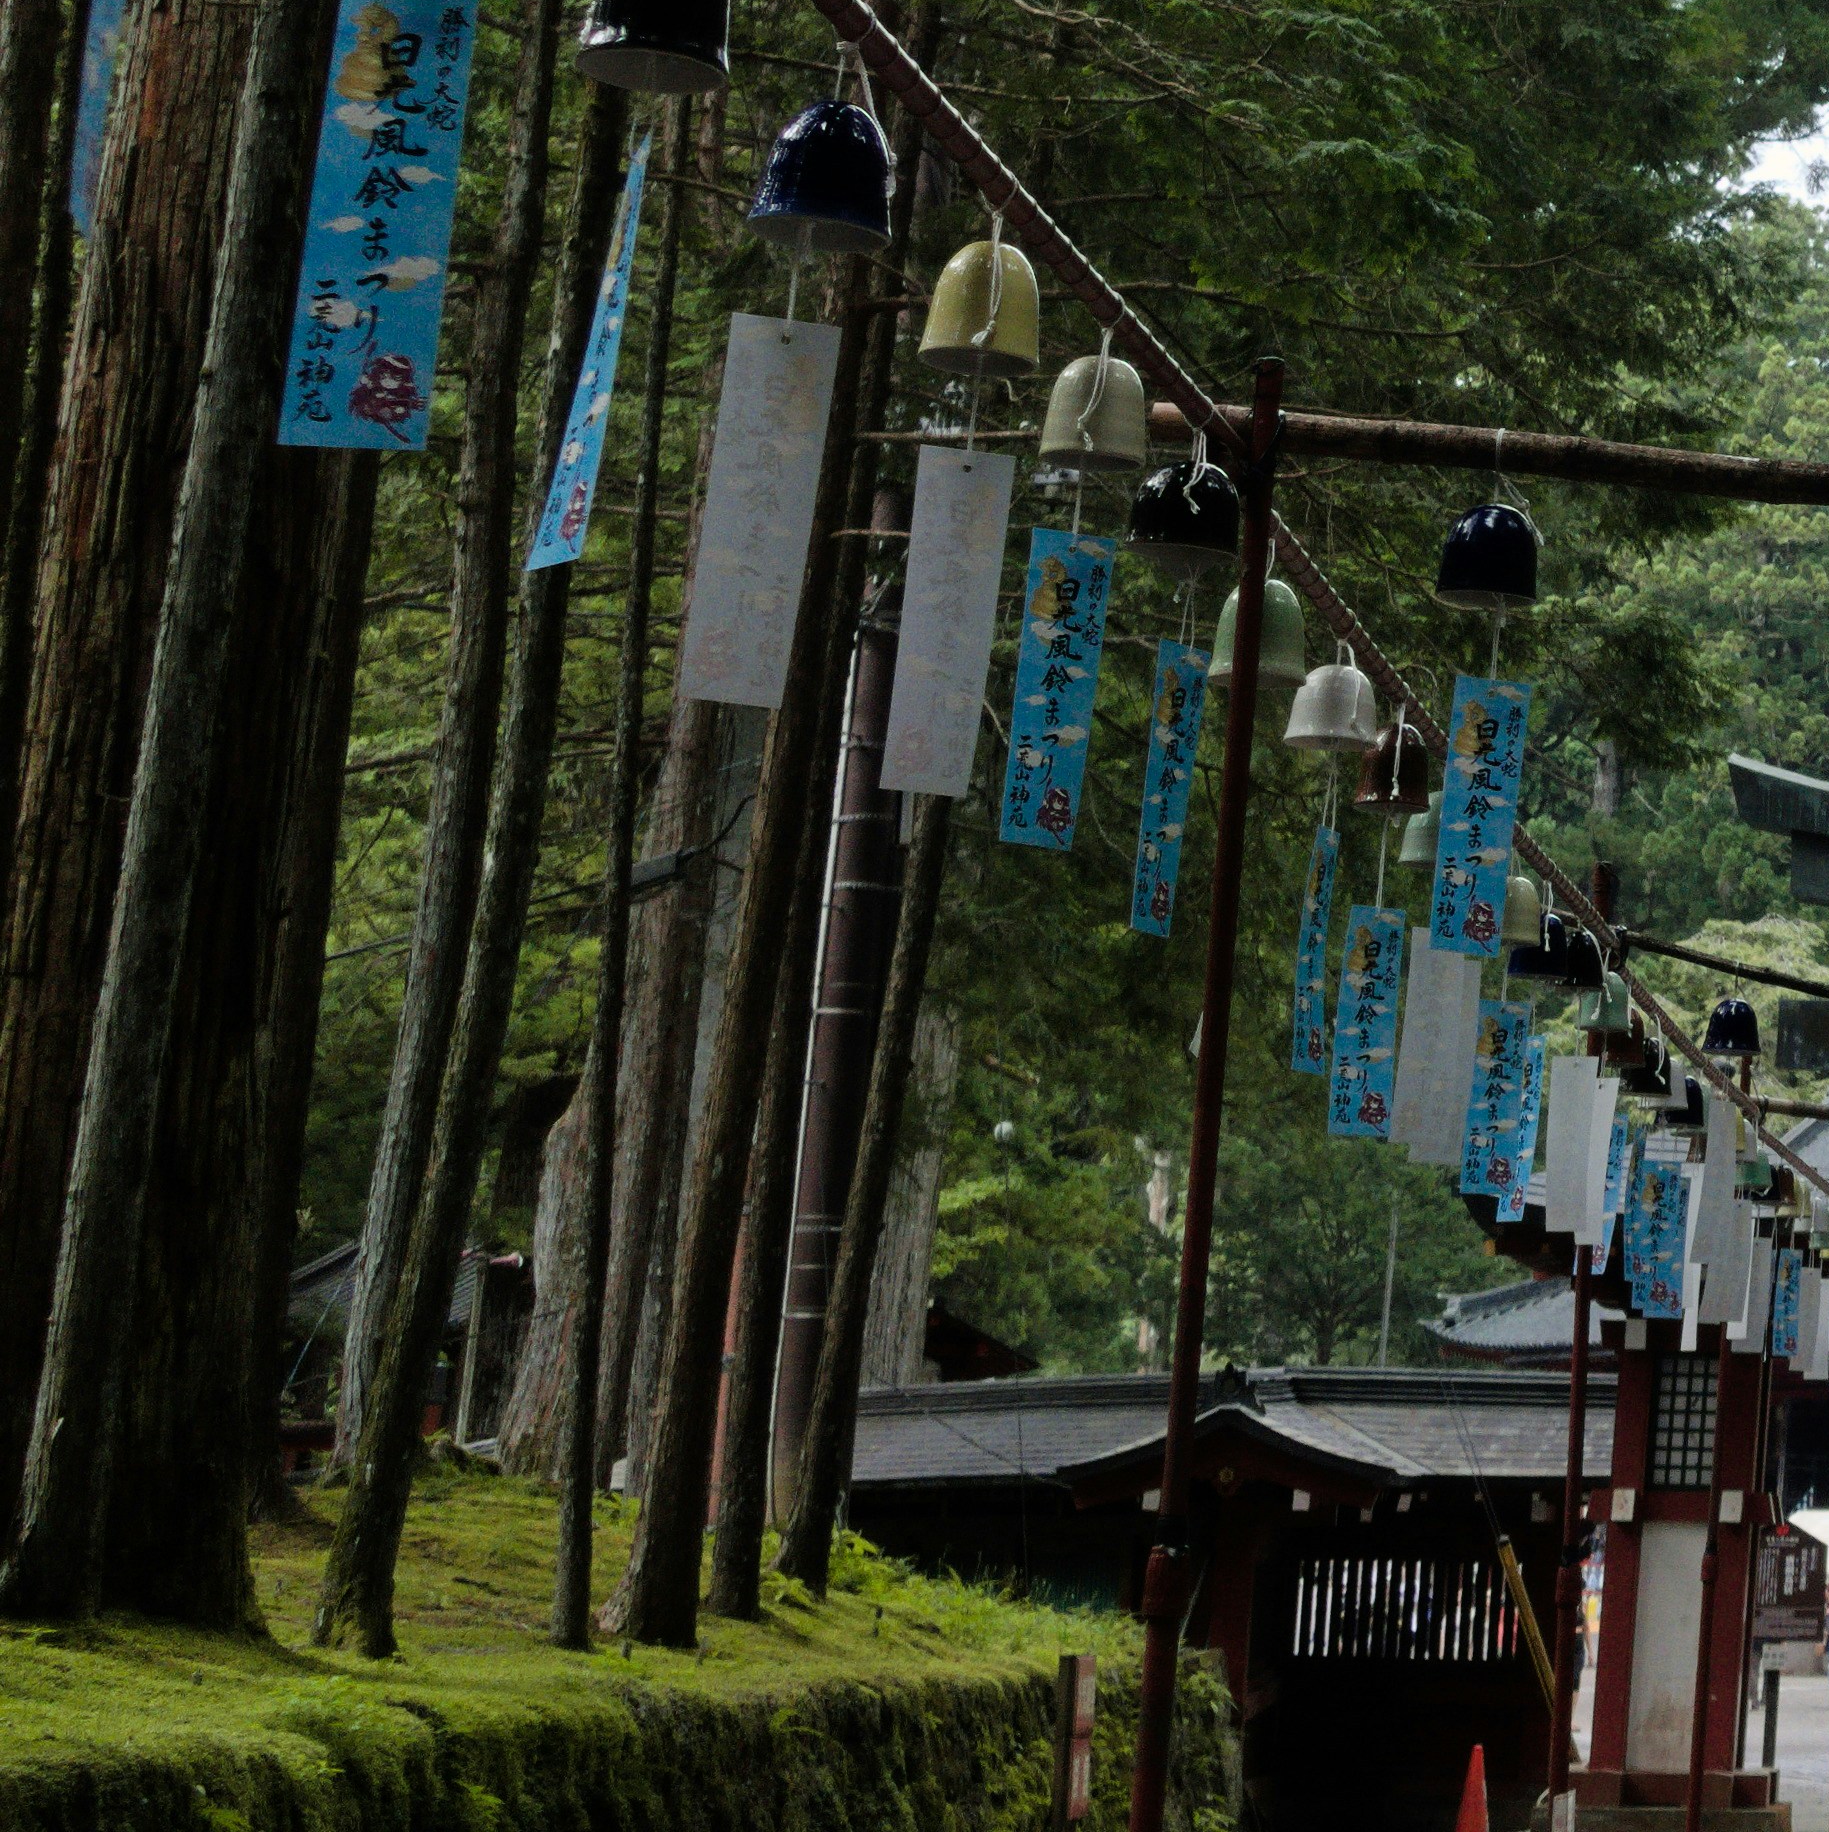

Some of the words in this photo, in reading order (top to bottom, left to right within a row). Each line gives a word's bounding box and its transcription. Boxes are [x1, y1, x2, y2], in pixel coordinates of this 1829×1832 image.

[348, 32, 428, 356] 日光風鈴まつり
[1039, 578, 1083, 787] 日光風鈴まつり
[1461, 719, 1503, 902] 日光風鈴まつり
[1353, 940, 1385, 1094] 日光風鈴まつり
